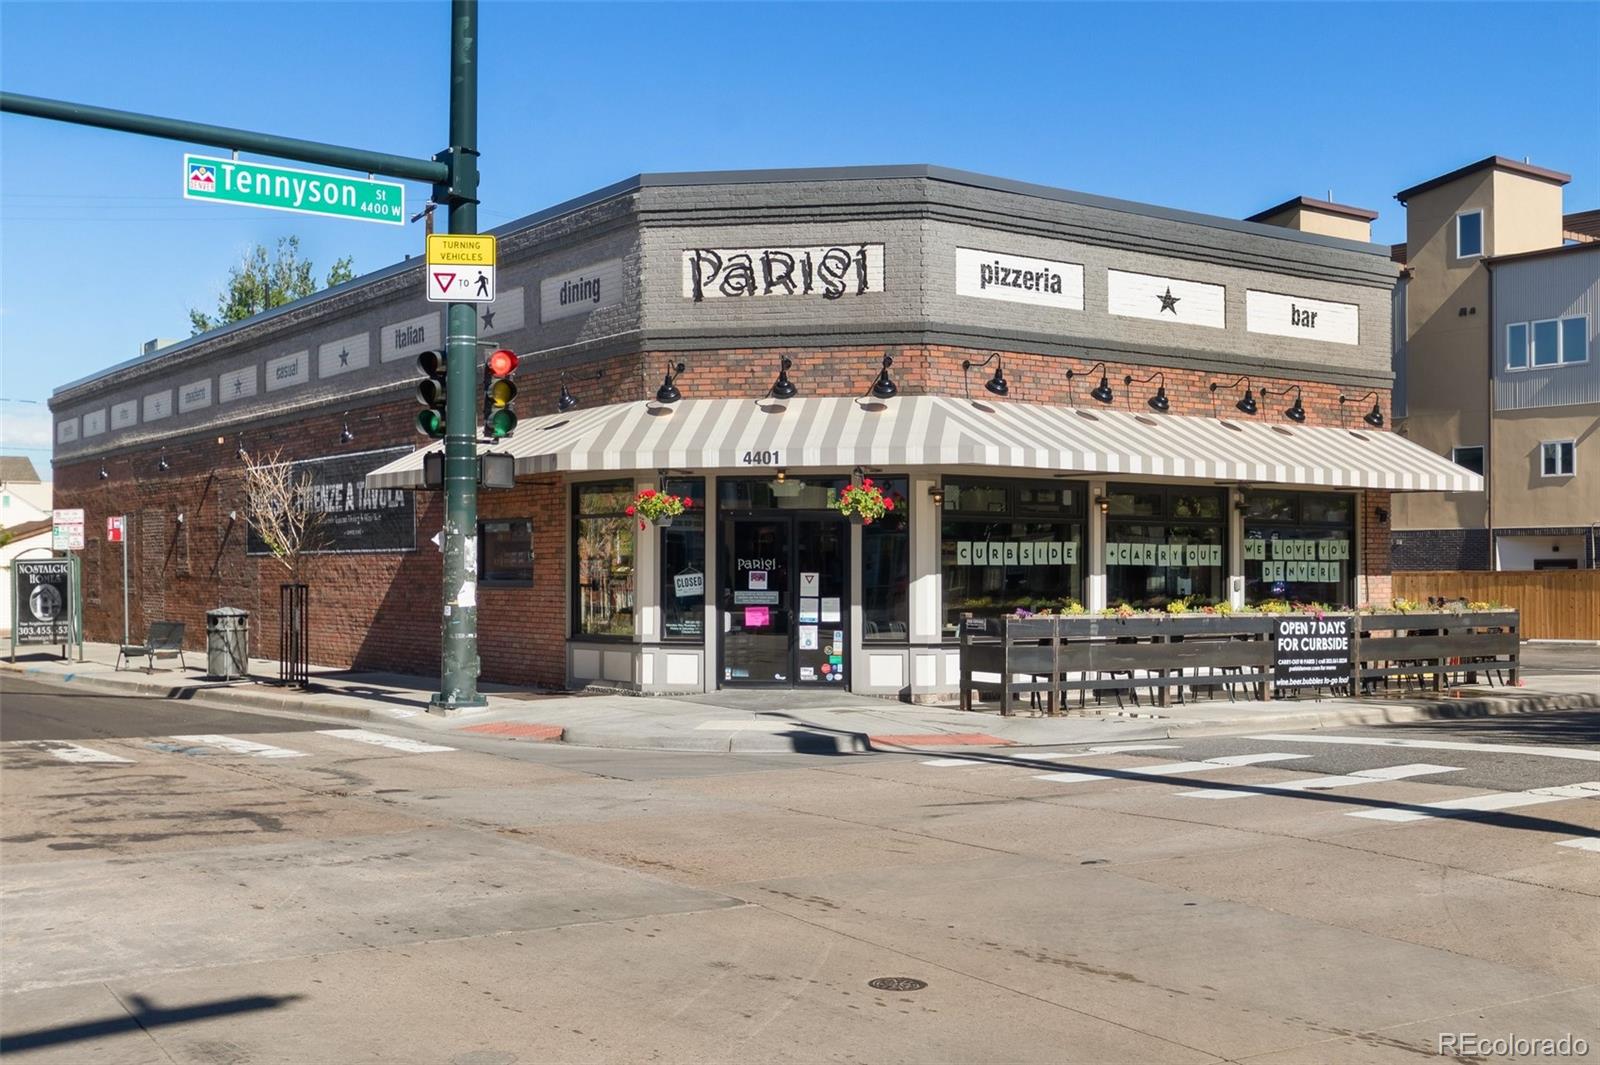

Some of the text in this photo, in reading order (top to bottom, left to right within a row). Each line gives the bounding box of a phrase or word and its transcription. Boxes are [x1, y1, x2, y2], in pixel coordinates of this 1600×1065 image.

[222, 164, 357, 207] Tennyson
[375, 188, 386, 201] St
[360, 201, 401, 217] 4400 W
[442, 240, 481, 250] TURNING
[440, 252, 483, 262] VEHICLES
[458, 278, 470, 289] TO
[980, 260, 1063, 295] pizzeria
[559, 277, 601, 306] dining
[1290, 303, 1318, 329] bar
[394, 325, 425, 350] italian
[276, 358, 298, 380] casual
[743, 450, 779, 465] 4401
[345, 482, 355, 511] A
[960, 548, 1073, 559] CURBSIDE
[1189, 550, 1218, 560] OUT
[1274, 545, 1312, 555] LOVE
[1321, 545, 1346, 554] YOU
[18, 564, 69, 574] NOSTALGIC
[1265, 567, 1336, 576] DENVER!
[676, 576, 703, 588] CLOSED
[1280, 621, 1346, 635] OPEN 7 DAYS
[1278, 637, 1349, 651] FOR CURBSIDE
